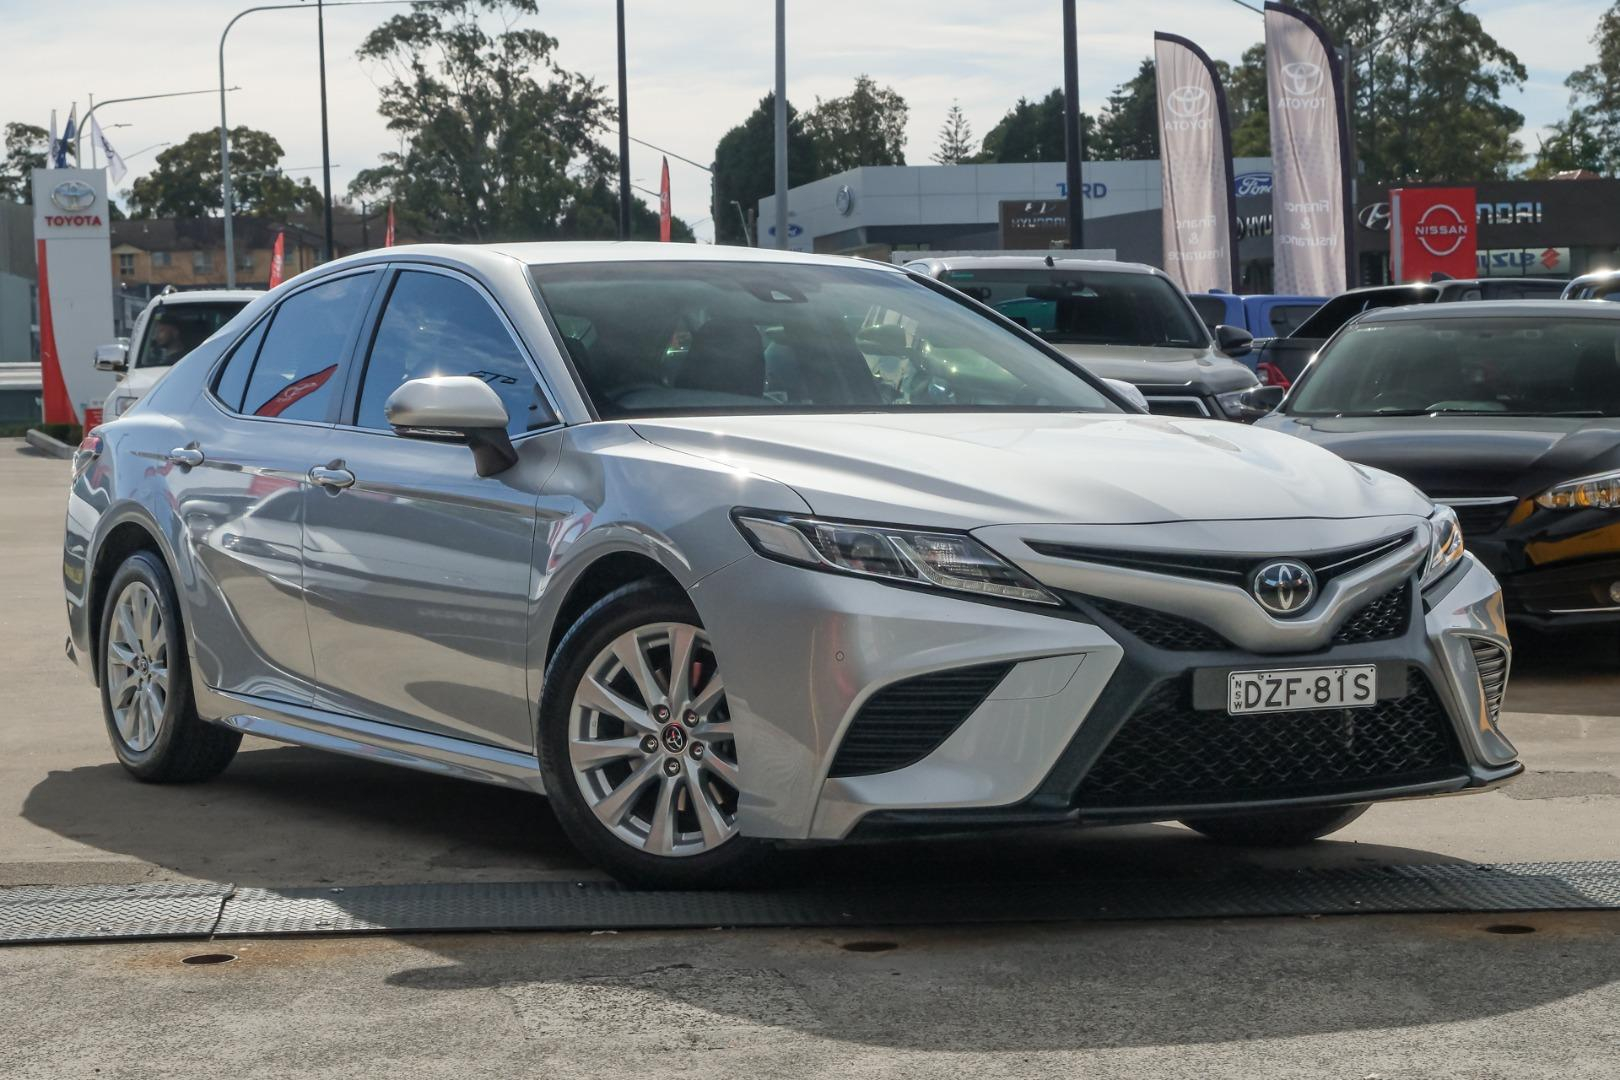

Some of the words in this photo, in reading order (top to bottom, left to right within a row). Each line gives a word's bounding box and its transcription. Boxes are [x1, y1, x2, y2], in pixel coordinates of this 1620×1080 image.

[44, 215, 102, 227] TOYOTA
[1476, 202, 1542, 224] NDAI
[1246, 214, 1273, 238] HYU
[1415, 225, 1467, 235] NISSAN
